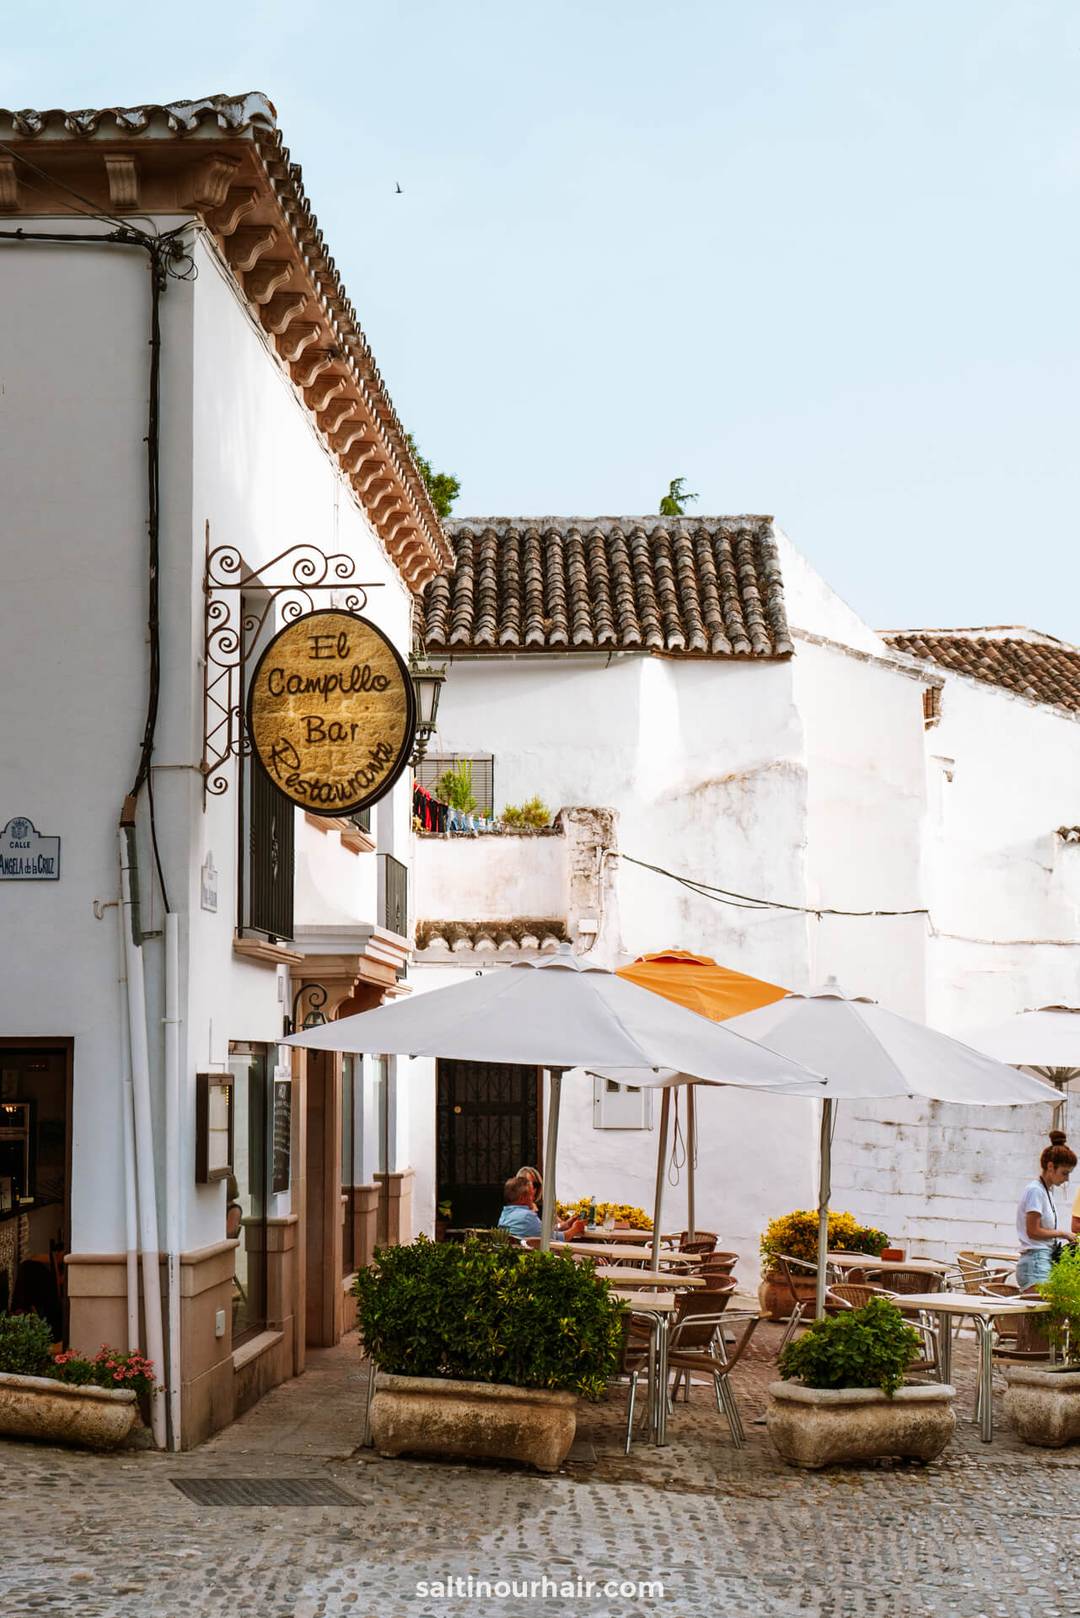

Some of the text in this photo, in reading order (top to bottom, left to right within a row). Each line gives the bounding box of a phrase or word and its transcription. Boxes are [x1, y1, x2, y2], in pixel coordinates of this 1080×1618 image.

[307, 632, 350, 660] El
[268, 664, 391, 702] Campillo
[301, 716, 359, 743] Bar
[269, 737, 393, 803] Restaurante
[9, 841, 31, 849] CALLE
[25, 857, 31, 874] de
[32, 857, 37, 875] la
